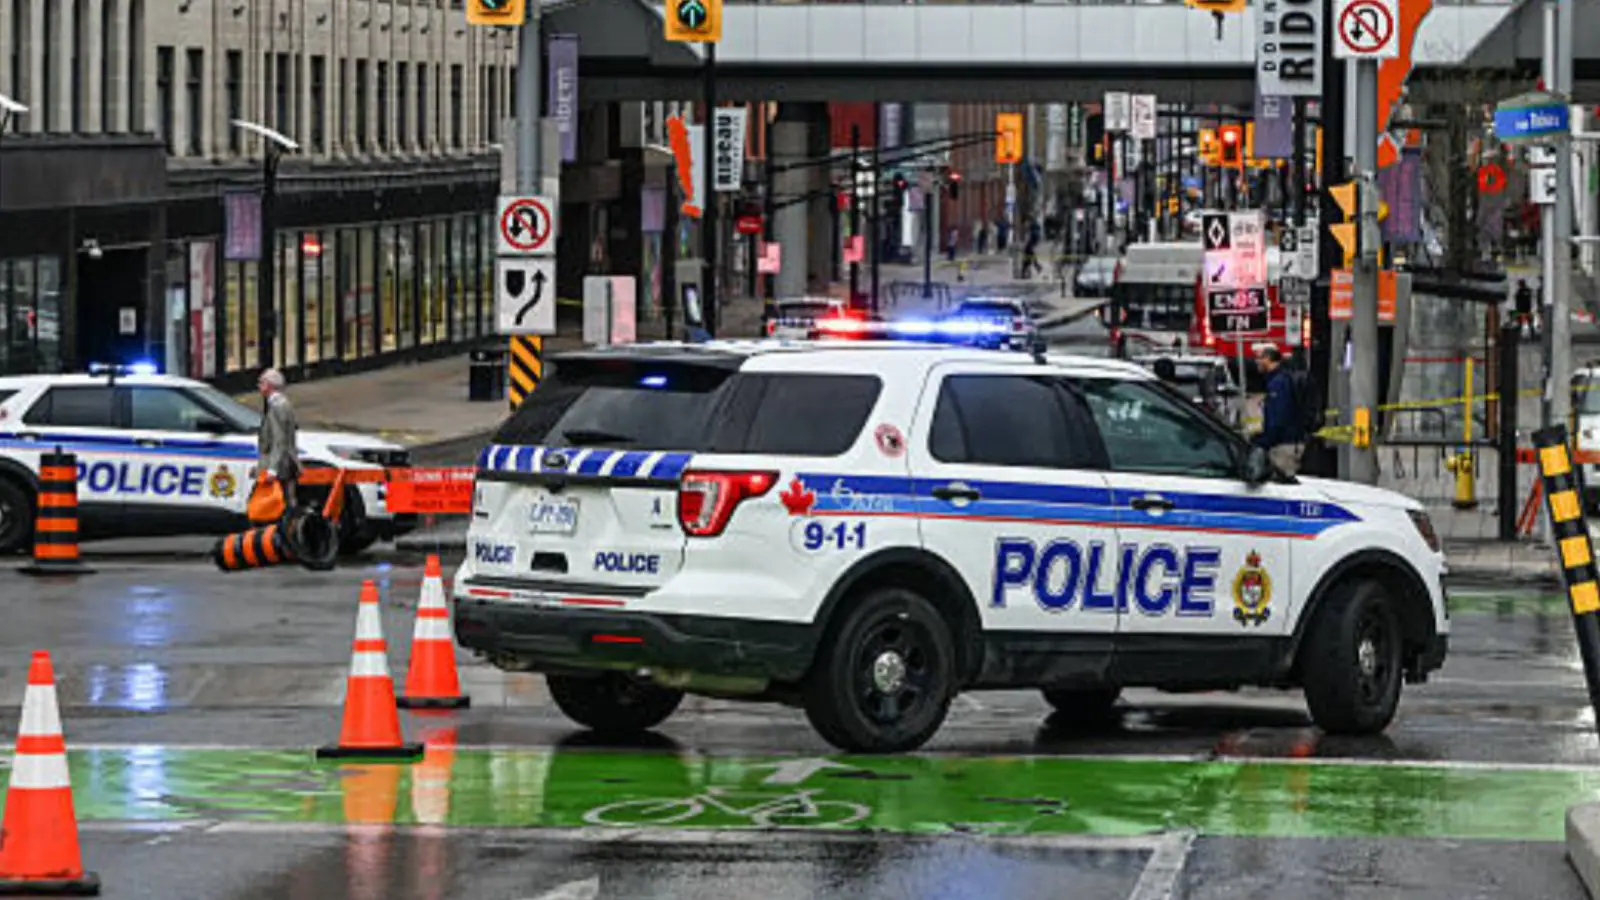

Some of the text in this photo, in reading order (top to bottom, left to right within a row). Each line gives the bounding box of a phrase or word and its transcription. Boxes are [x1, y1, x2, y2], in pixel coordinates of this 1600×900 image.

[1279, 0, 1315, 80] RID
[594, 551, 661, 575] POLICE
[989, 536, 1222, 617] POLICE
